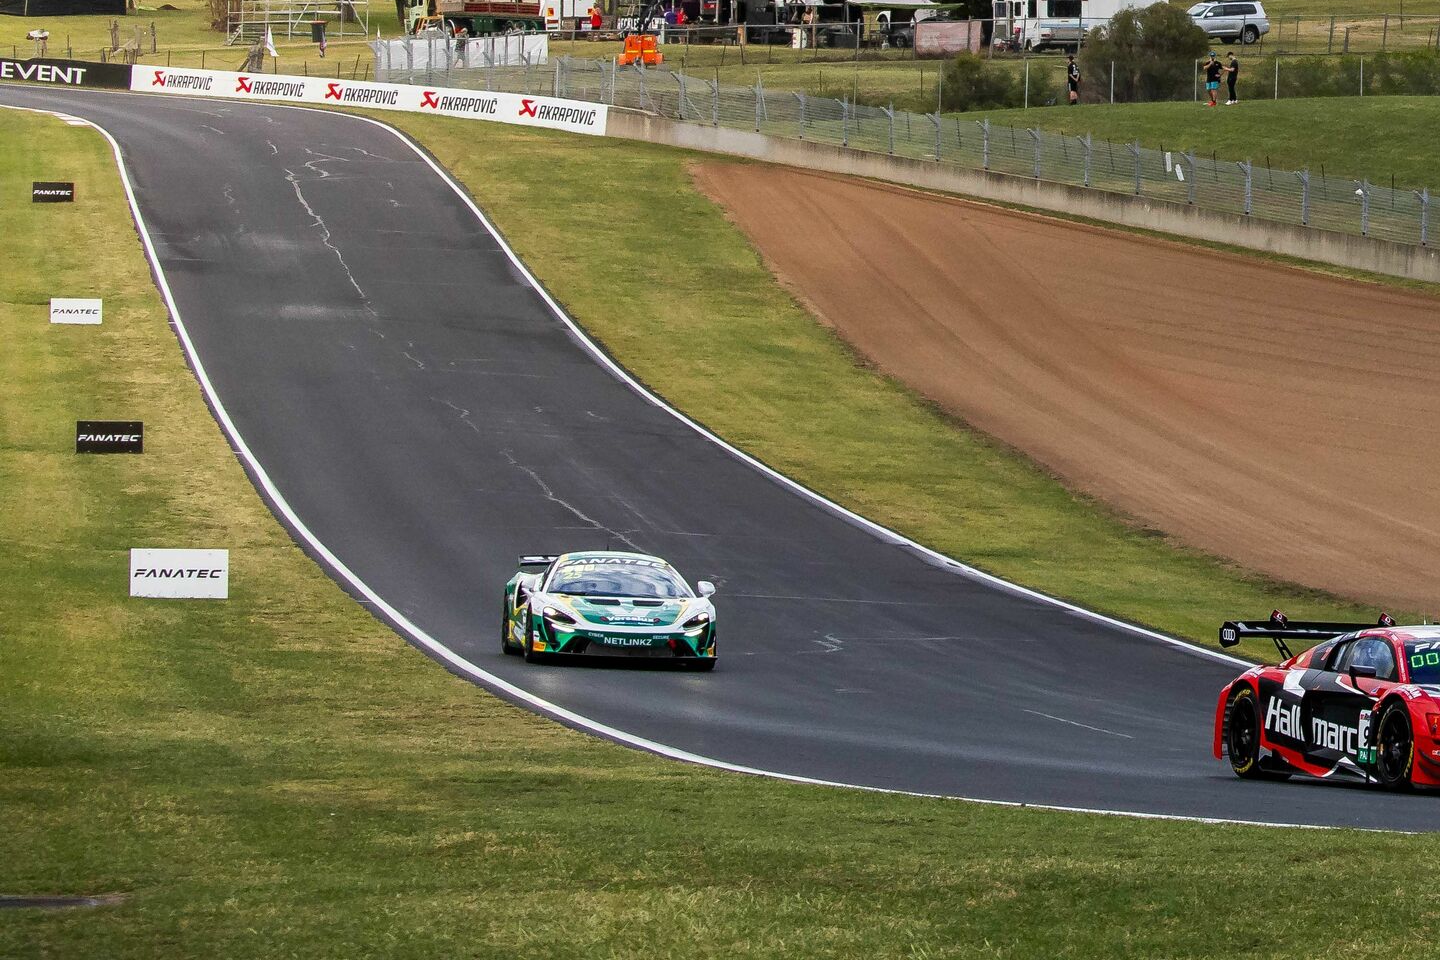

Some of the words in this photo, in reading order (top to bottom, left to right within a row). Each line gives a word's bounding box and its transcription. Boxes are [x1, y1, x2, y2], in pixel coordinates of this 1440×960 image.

[1, 61, 87, 84] EVENT
[77, 434, 141, 442] FANATEC
[134, 569, 222, 579] FANATEC
[603, 637, 652, 646] NETLINKZ
